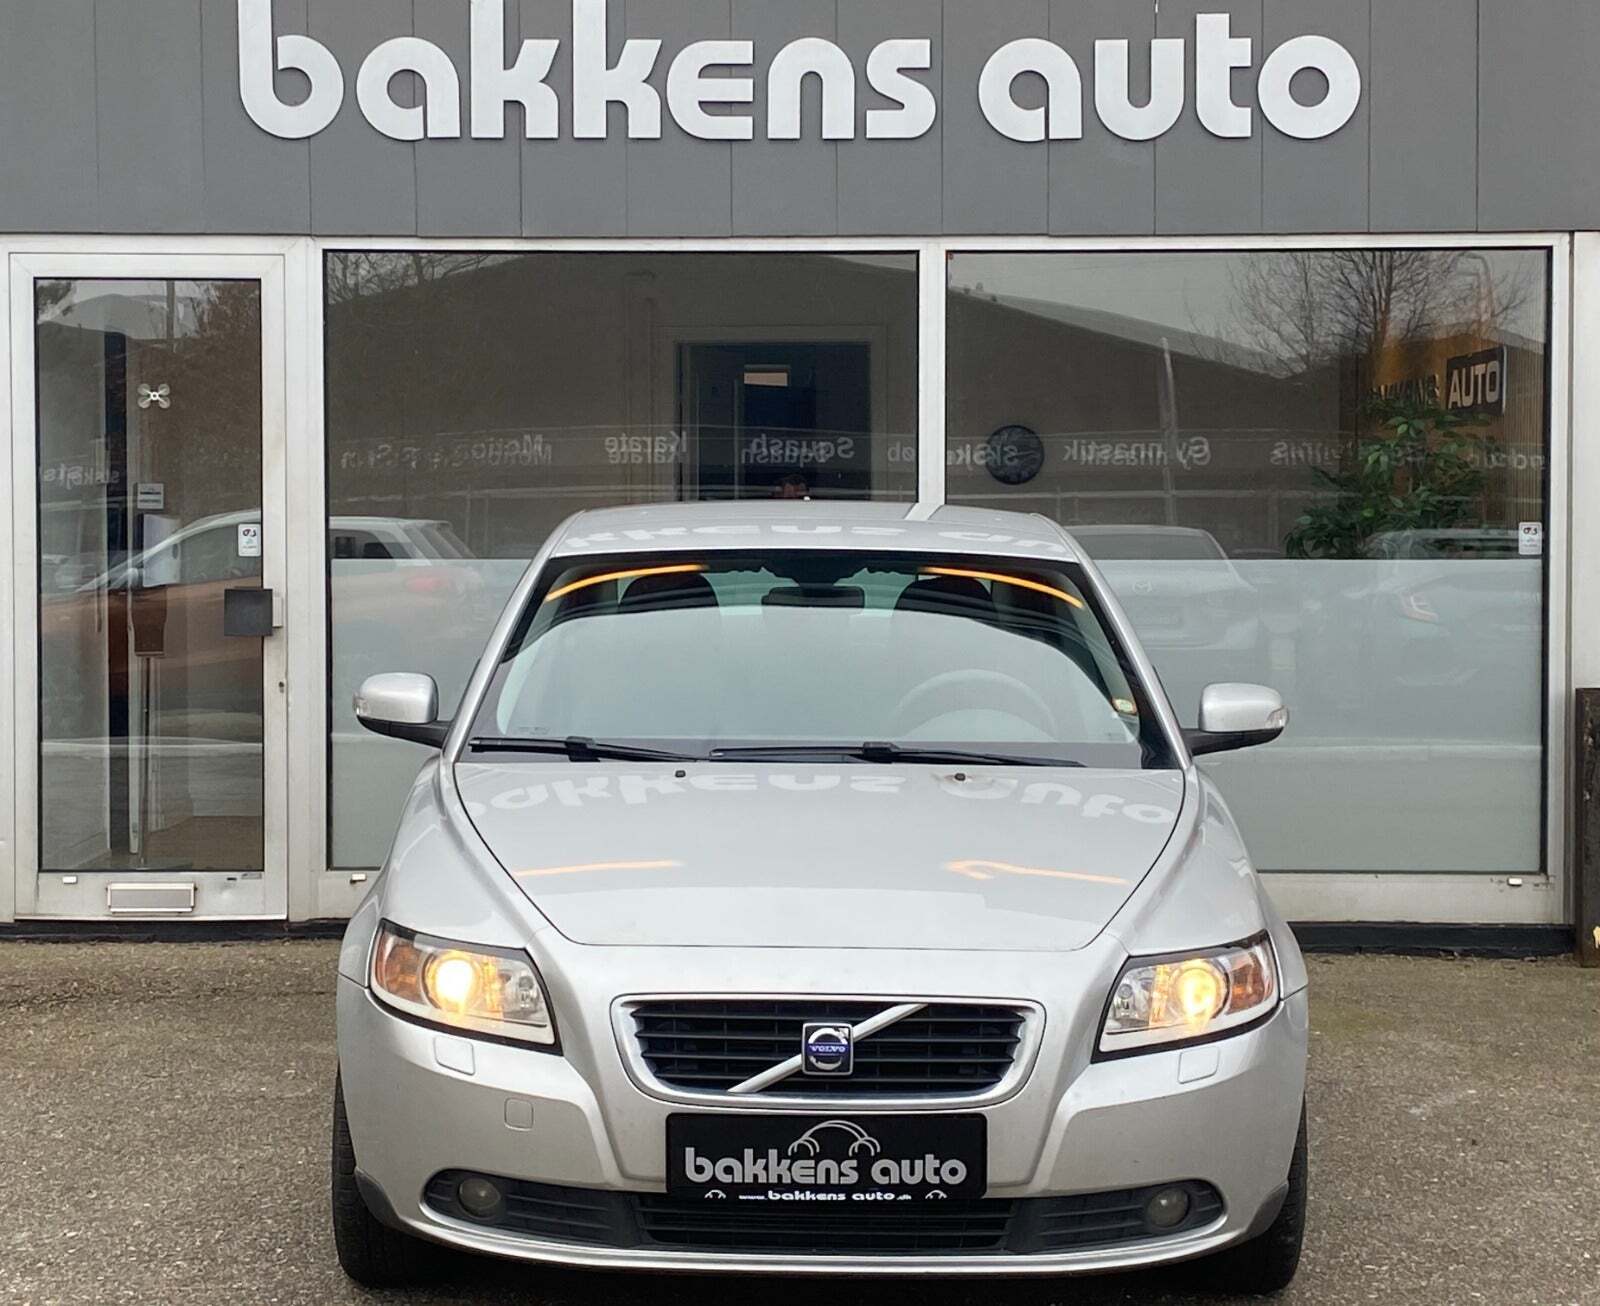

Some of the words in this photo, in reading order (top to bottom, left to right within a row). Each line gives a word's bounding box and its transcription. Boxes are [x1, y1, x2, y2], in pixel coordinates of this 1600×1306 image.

[238, 0, 937, 141] bakkens
[978, 12, 1362, 142] auto
[1448, 360, 1500, 409] AUTO
[809, 1045, 846, 1053] VOLVO
[685, 1147, 859, 1184] bakkens
[871, 1154, 968, 1185] auto
